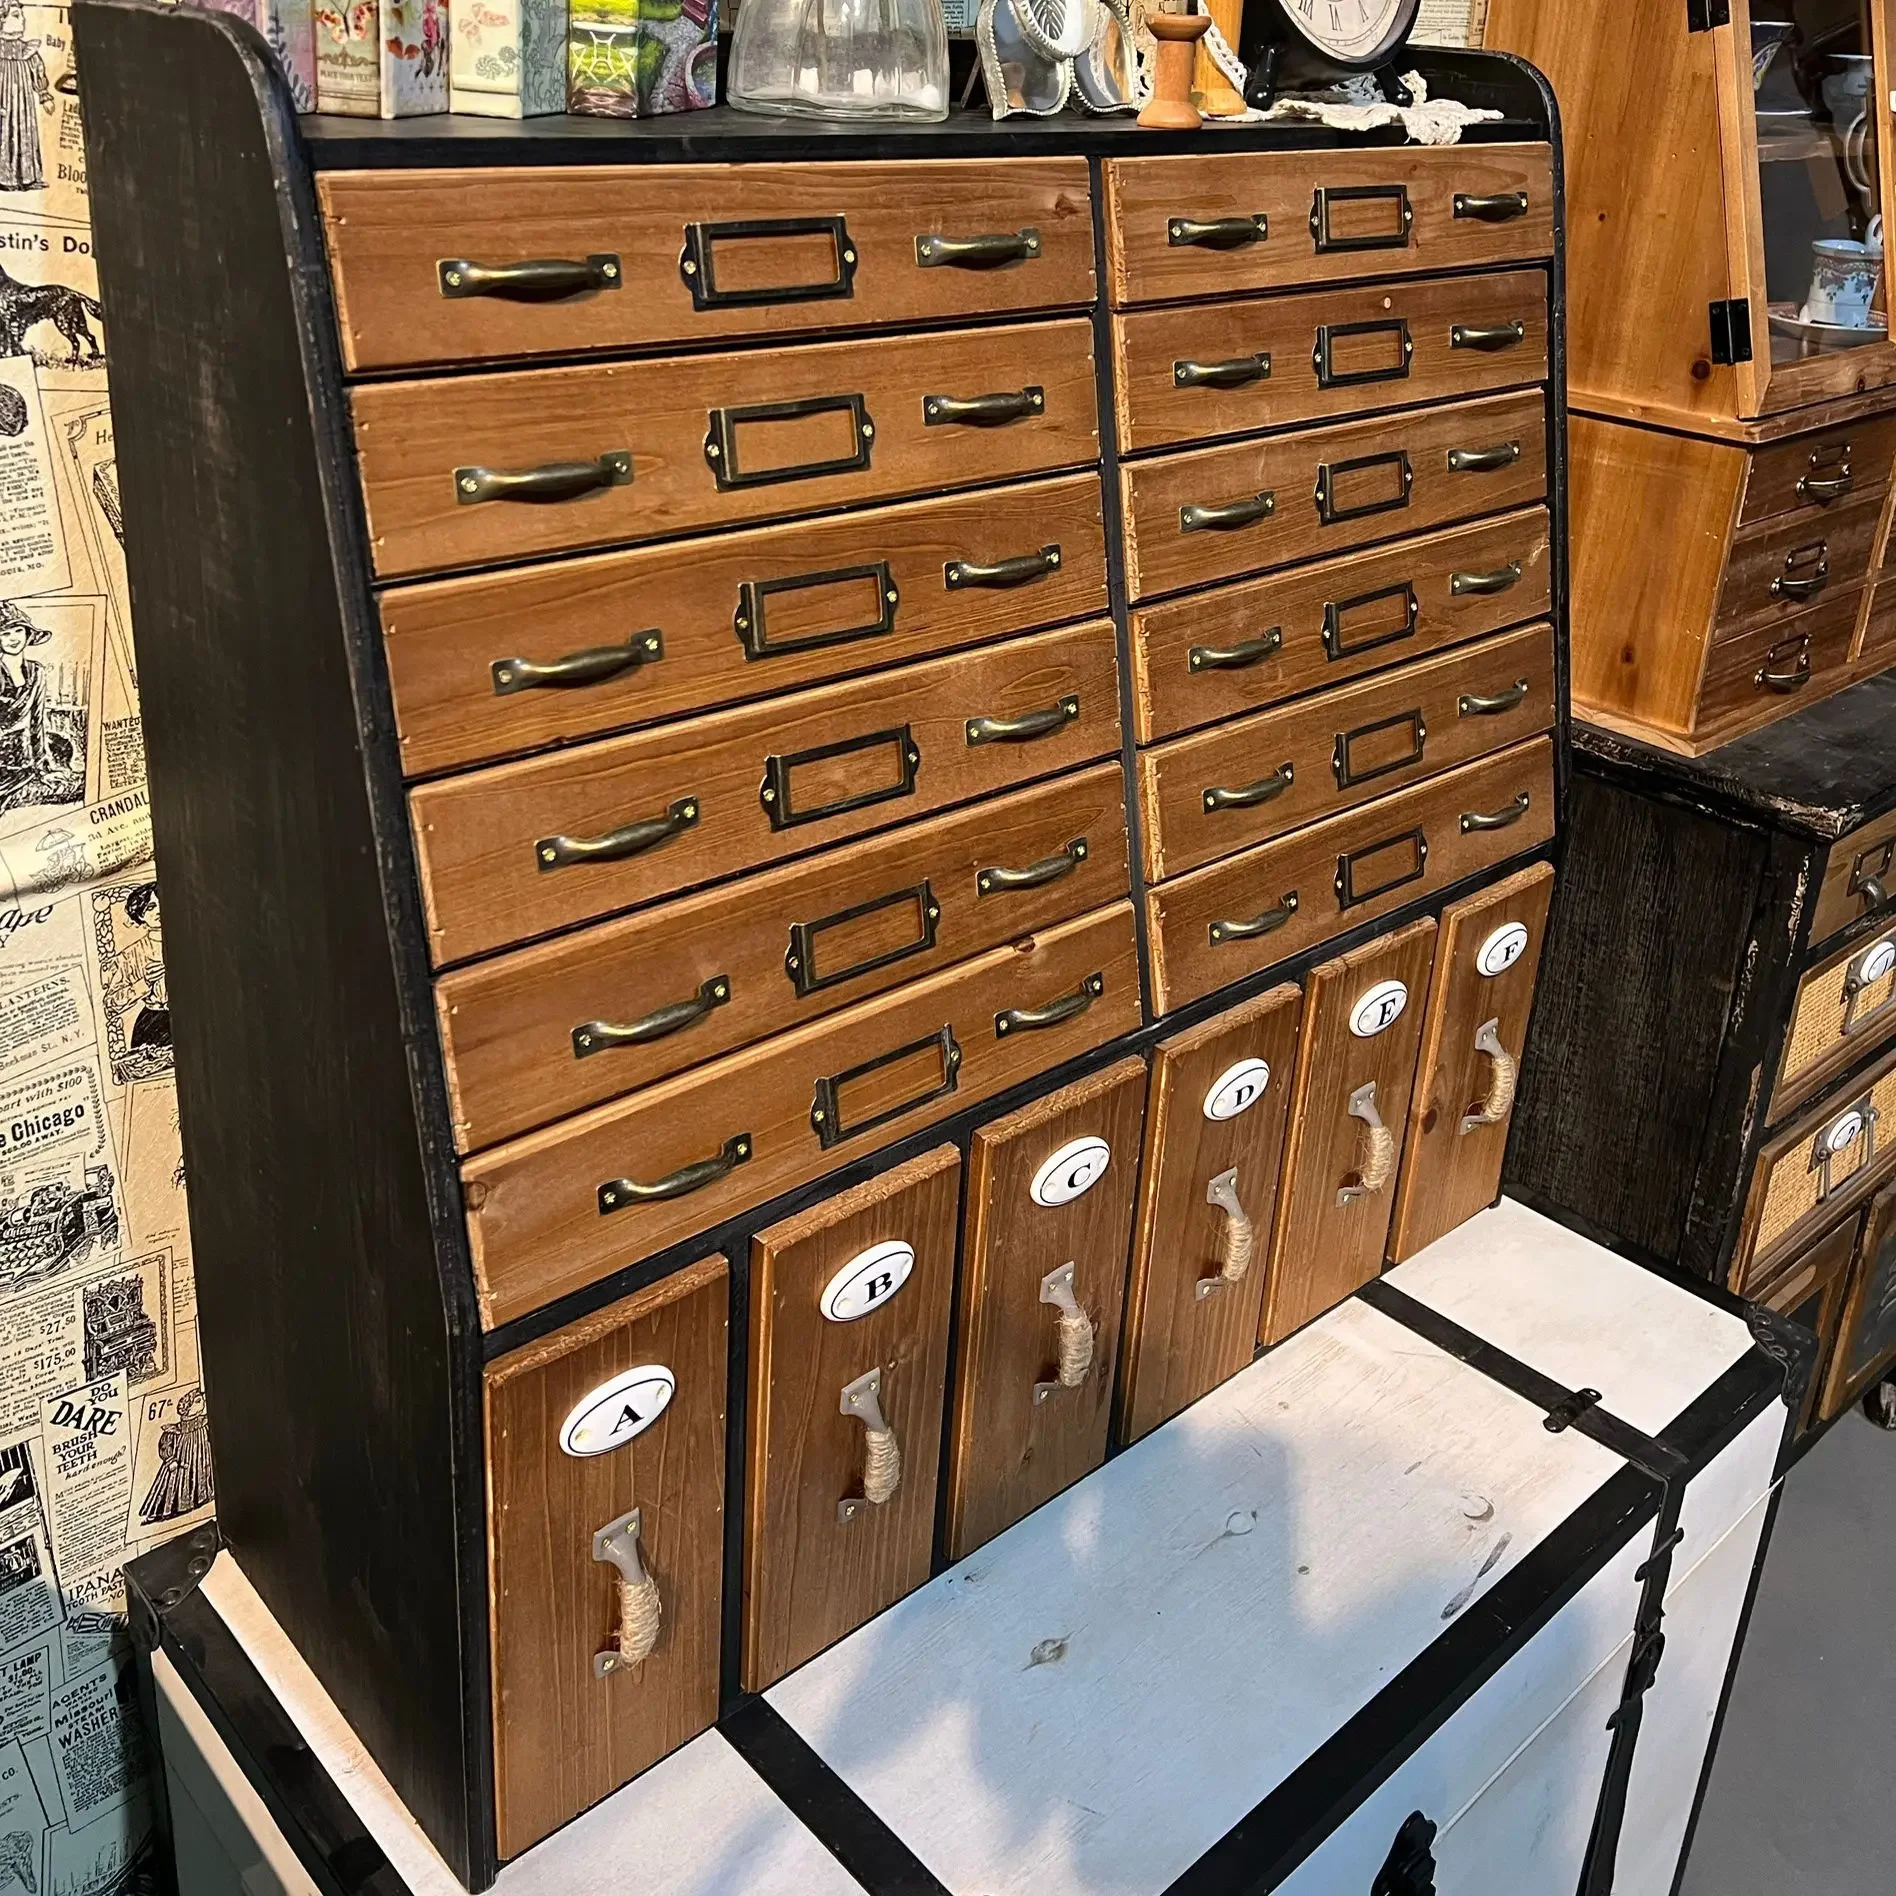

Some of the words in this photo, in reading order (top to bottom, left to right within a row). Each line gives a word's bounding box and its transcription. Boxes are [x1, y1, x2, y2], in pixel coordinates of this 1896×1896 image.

[103, 717, 141, 731] WANTED
[90, 791, 150, 825] CRANDAL
[1501, 941, 1518, 964] F
[1375, 997, 1396, 1029] E
[25, 1087, 53, 1104] with
[1233, 1085, 1254, 1108] D
[1067, 1163, 1091, 1188] C
[863, 1272, 893, 1304] B
[39, 1315, 76, 1335] $27.50
[33, 1347, 76, 1371] $175.00
[85, 1387, 119, 1406] YOU
[90, 1382, 111, 1397] DO
[49, 1400, 123, 1436] DARE
[608, 1404, 645, 1437] A
[52, 1431, 98, 1455] BRUSH
[58, 1441, 96, 1462] YOUR
[56, 1449, 98, 1475] TEETH
[65, 1462, 89, 1481] hard
[91, 1445, 127, 1469] enough?
[68, 1567, 125, 1603] IPANA
[101, 1578, 125, 1597] PAST
[13, 1652, 42, 1672] LAMP
[52, 1673, 107, 1710] AGENTS
[65, 1687, 98, 1708] WANTED
[58, 1706, 119, 1749] WASHER
[68, 1704, 104, 1729] STEAM
